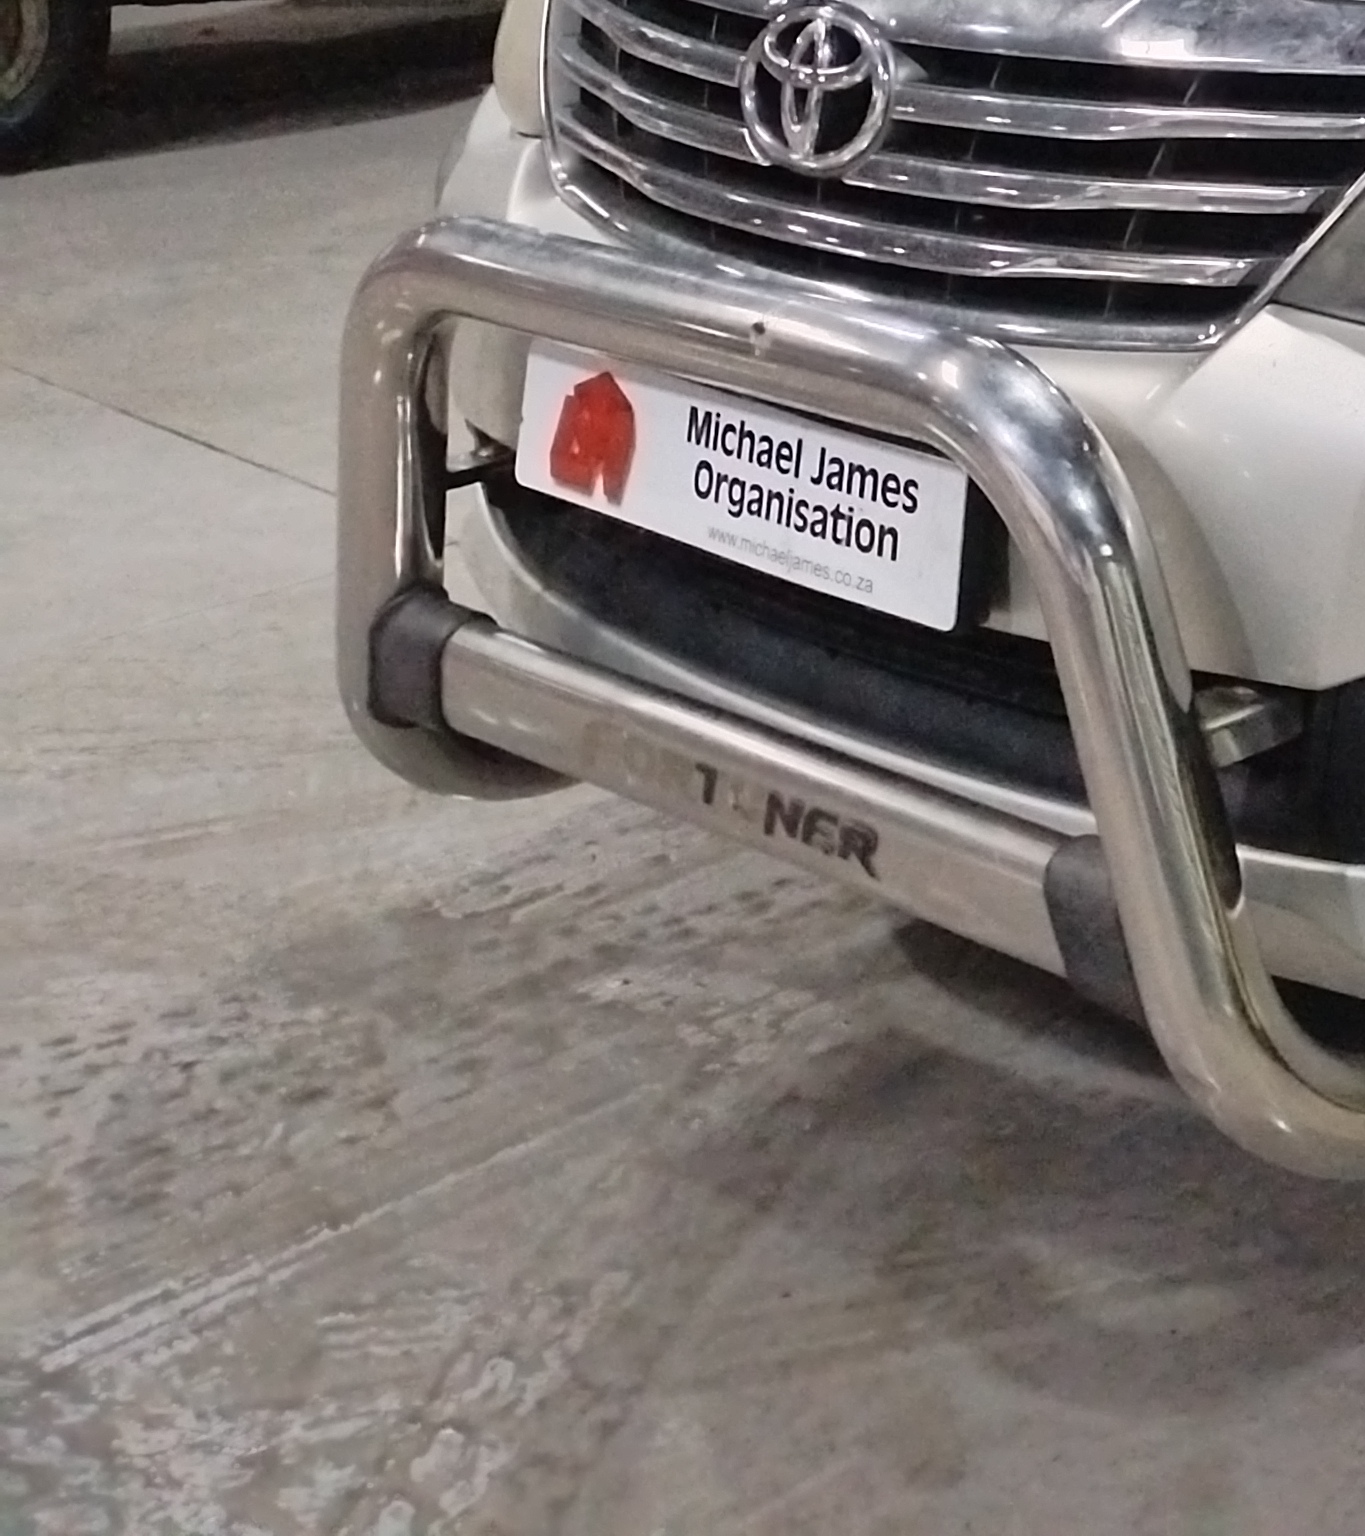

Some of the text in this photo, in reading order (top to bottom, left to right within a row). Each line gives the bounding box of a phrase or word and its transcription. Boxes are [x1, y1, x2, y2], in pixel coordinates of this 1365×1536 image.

[687, 405, 919, 514] Michael James
[693, 459, 899, 562] Organisation
[706, 525, 874, 594] www.michaeljames.co.za
